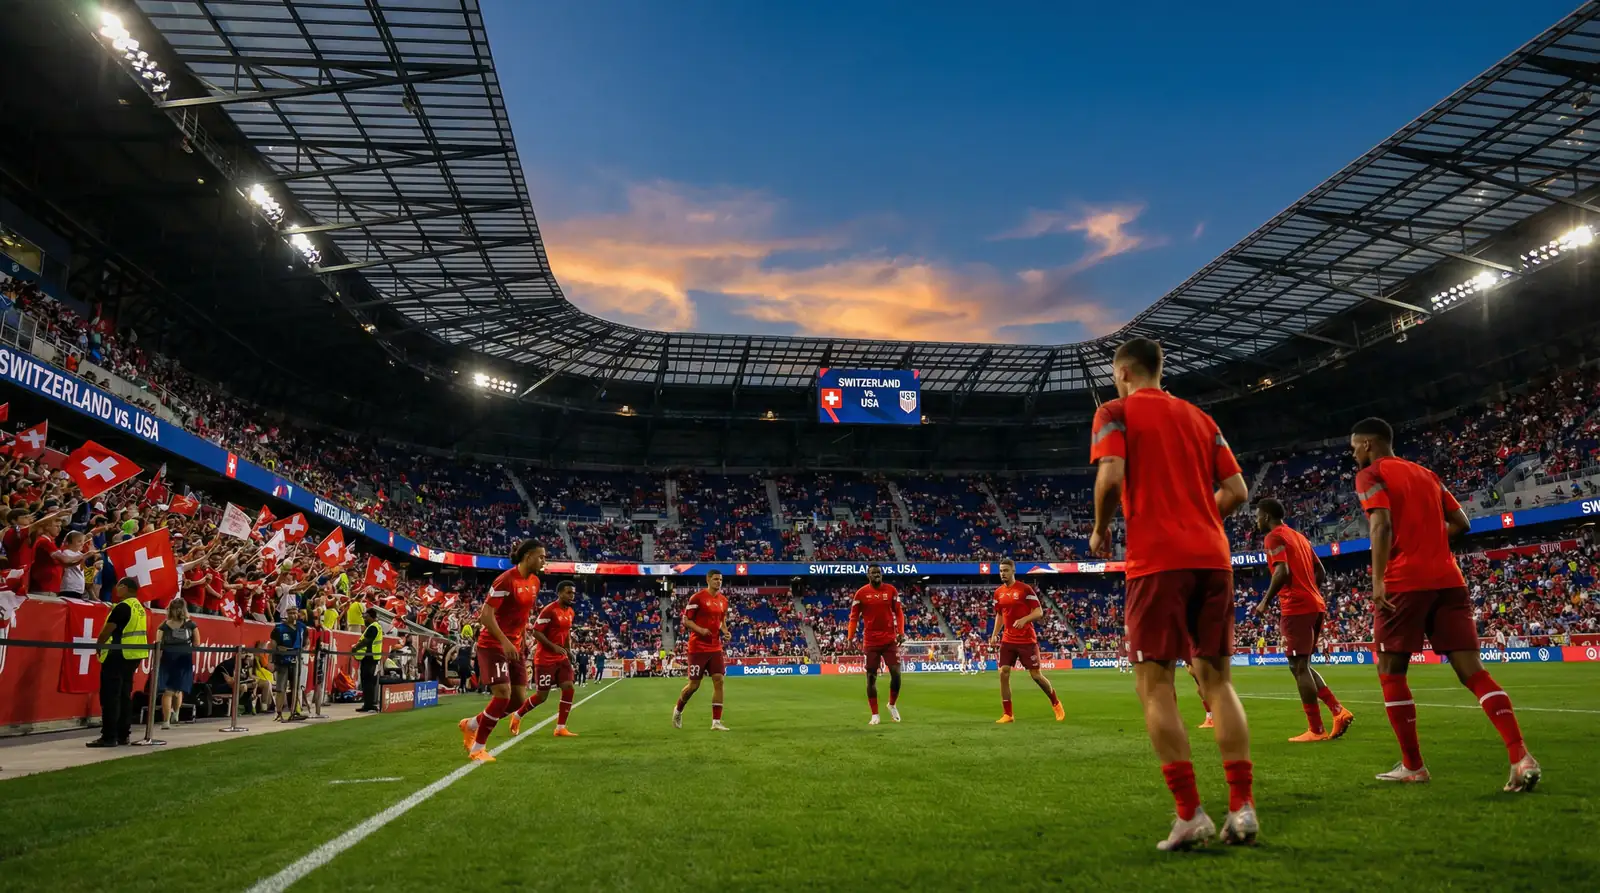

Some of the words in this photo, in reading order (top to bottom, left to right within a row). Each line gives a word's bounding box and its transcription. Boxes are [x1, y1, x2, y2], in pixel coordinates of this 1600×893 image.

[838, 378, 901, 388] SWITZERLAND
[0, 349, 112, 420] SWITZERLAND
[114, 407, 131, 430] vs.
[135, 412, 159, 442] USA
[864, 390, 876, 398] vs.
[861, 398, 879, 408] USA
[809, 564, 869, 574] SWITZERLA
[882, 566, 895, 574] vs.
[897, 564, 918, 574] USA
[1480, 649, 1531, 662] ooking.com
[1089, 658, 1119, 668] Booking
[495, 662, 508, 678] 14
[743, 666, 793, 676] Booking.com
[539, 674, 551, 687] 22
